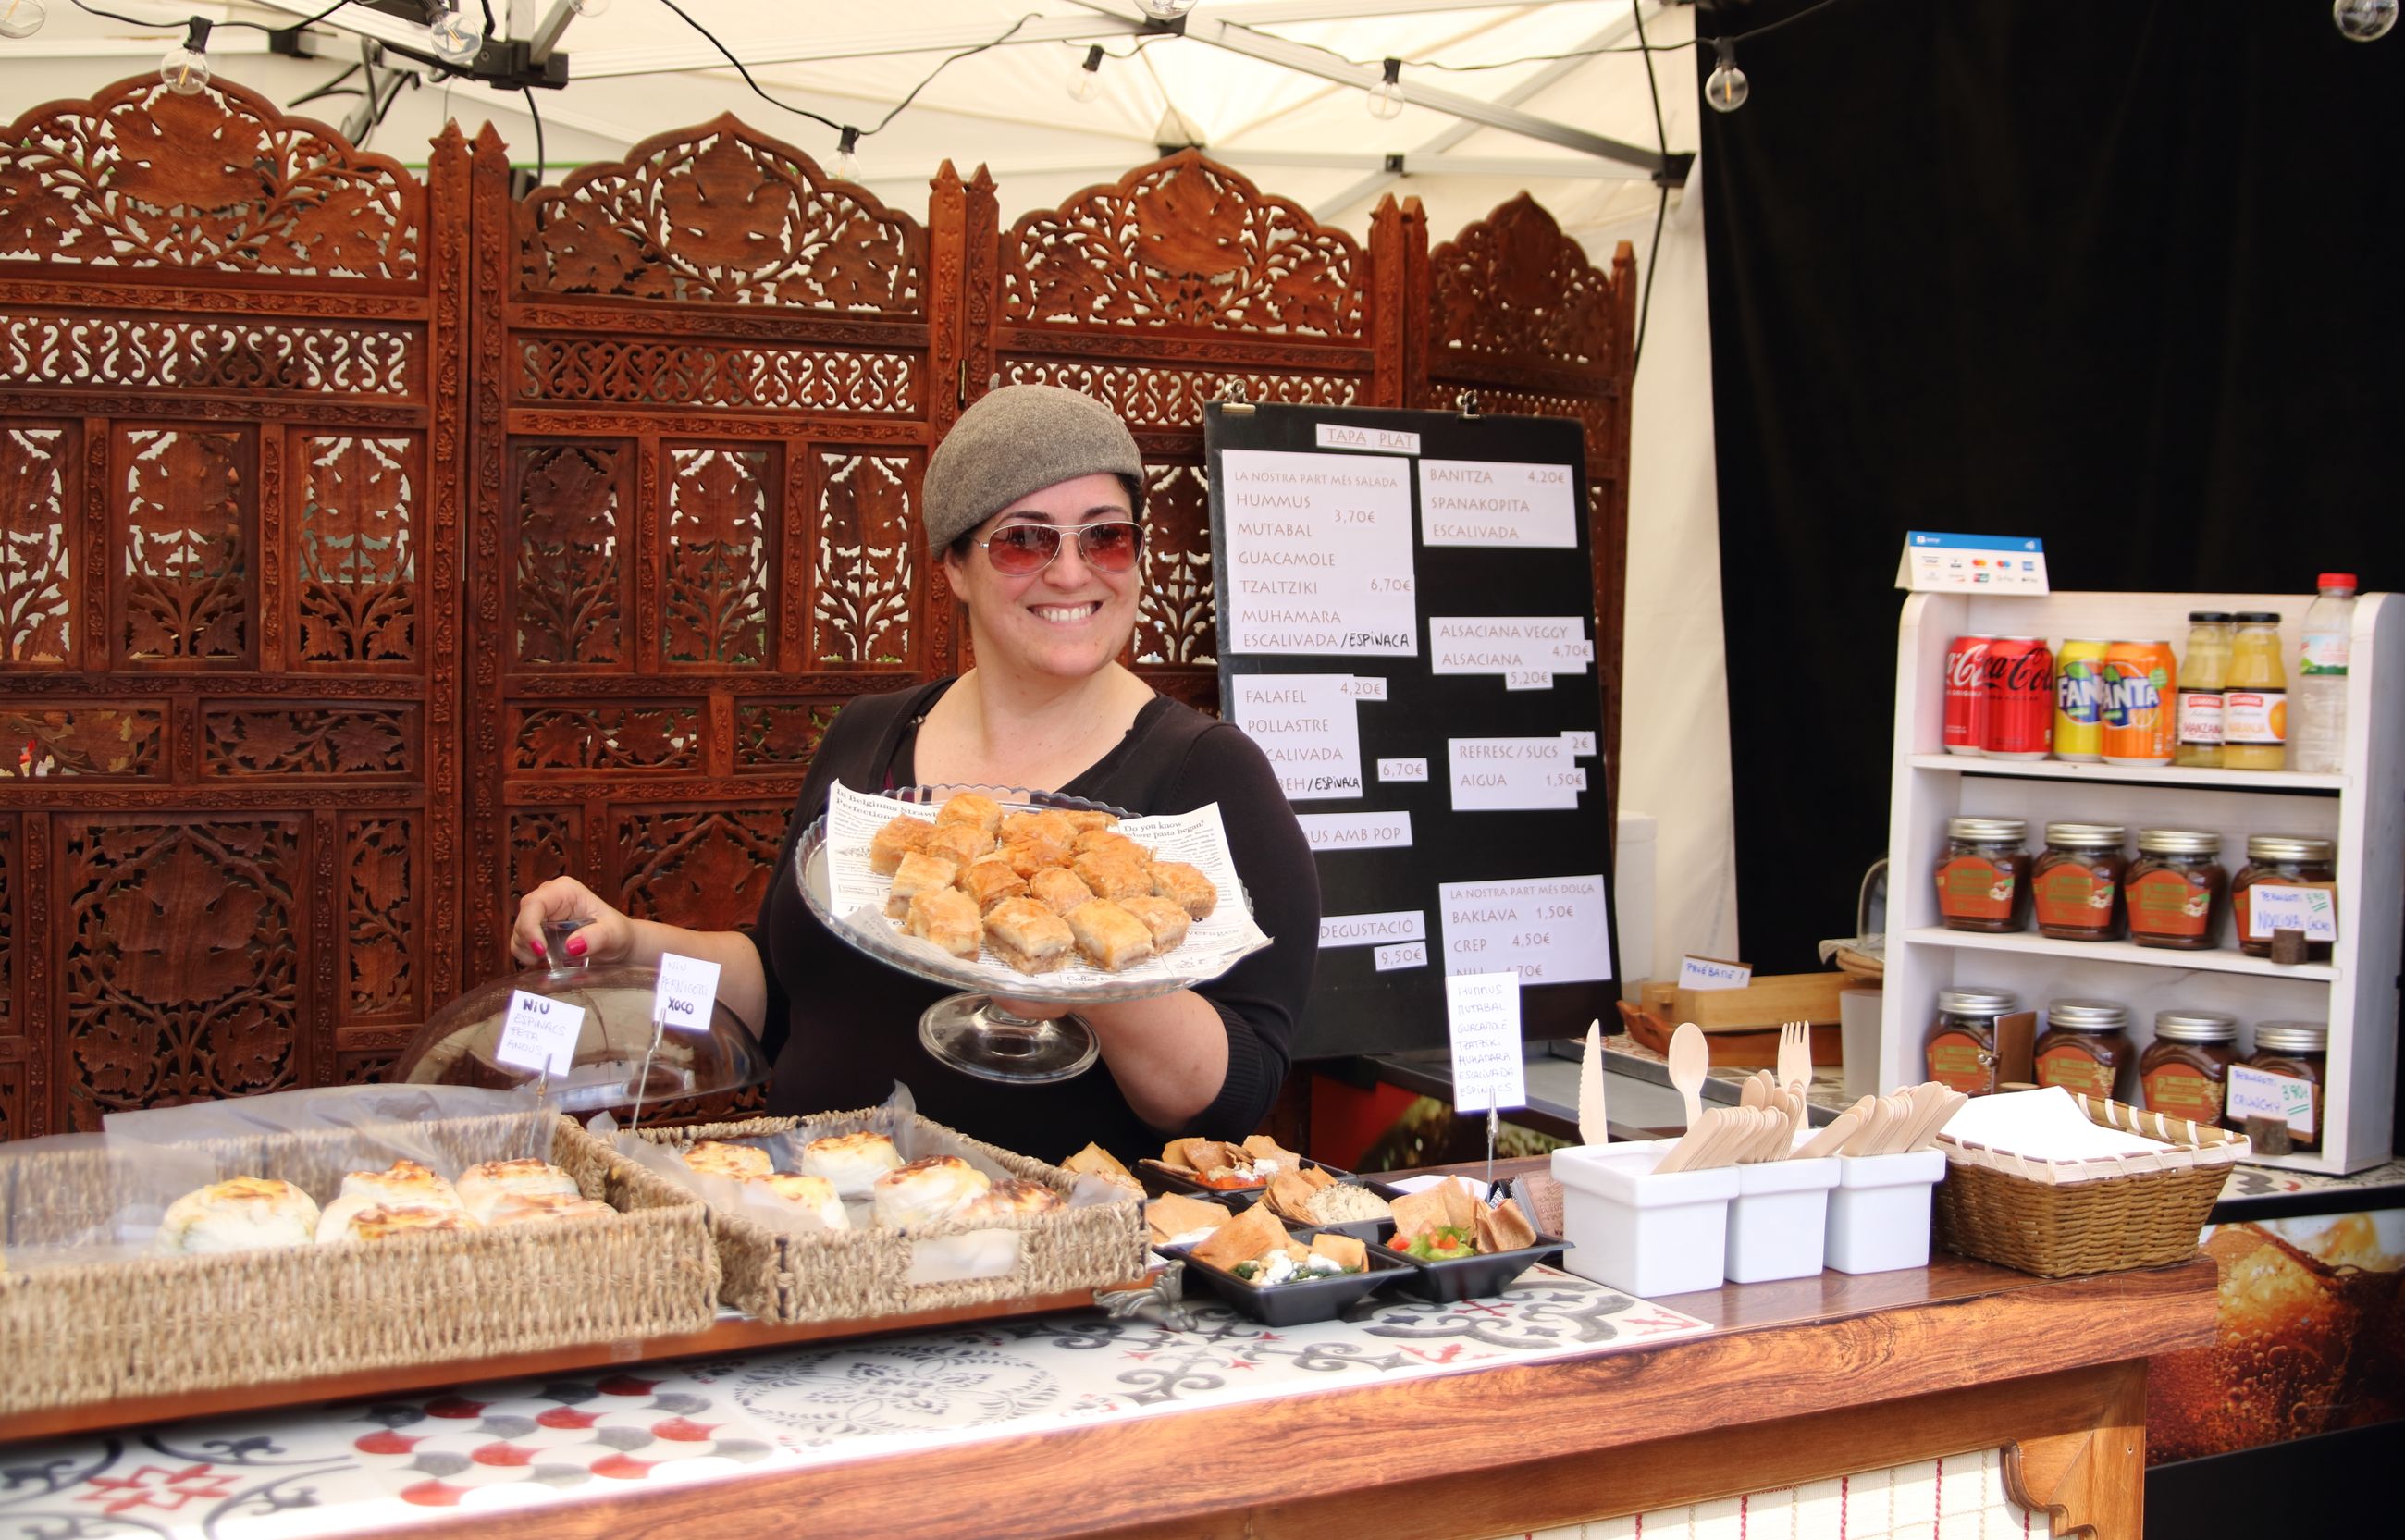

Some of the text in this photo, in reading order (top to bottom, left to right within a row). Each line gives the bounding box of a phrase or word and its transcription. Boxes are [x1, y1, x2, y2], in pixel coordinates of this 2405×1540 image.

[1326, 428, 1414, 448] TAPA PLAT
[1235, 471, 1248, 481] LA
[1252, 473, 1297, 483] NOSTRA
[1301, 474, 1327, 485] PART
[1355, 476, 1398, 487] SALADA
[1430, 469, 1565, 484] BANITZA 4,20€
[1237, 493, 1311, 509] HUMMUS
[1431, 497, 1530, 512] SPANAKOPITA
[1335, 510, 1376, 524] 3,70€
[1237, 523, 1314, 537] MUTABAL
[1433, 524, 1519, 539] ESCALIVADA
[1239, 550, 1336, 567] GUACAMOLE
[1240, 578, 1412, 594] TZALTZIKI 6,70€
[1241, 610, 1342, 623] MUHAMARA
[1440, 624, 1569, 639] ALSACIANA VEGGY
[1552, 645, 1589, 658] 4,70€
[1442, 653, 1523, 666] ALSACIANA
[1511, 671, 1548, 685] 5,20€
[1246, 682, 1382, 704] FALAFEL 4,20€
[2102, 677, 2161, 711] ANTA
[1248, 719, 1329, 733] POLLASTRE
[1572, 736, 1589, 749] 2€
[1265, 747, 1344, 762] CALIVADA
[1383, 762, 1424, 777] 6,70€
[1461, 773, 1583, 787] AIGUA 1,50€
[836, 787, 937, 819] In Belgiums Straw
[1141, 823, 1156, 832] you
[1153, 831, 1175, 839] pasta
[1177, 819, 1204, 834] began?
[1334, 828, 1368, 843] AMB
[1374, 827, 1400, 841] POP
[1450, 890, 1463, 899] LA
[1465, 887, 1507, 898] NOSTRA
[1510, 886, 1536, 896] PART
[1561, 883, 1595, 895] DOLÇA
[1452, 905, 1574, 924] BAKLAVA 1,50€
[1320, 917, 1414, 939] DEGUSTACIÓ
[1453, 932, 1551, 953] CREP 4,50€
[1381, 948, 1422, 966] 9,50€
[668, 996, 695, 1016] XOCO
[510, 1026, 539, 1041] FETA
